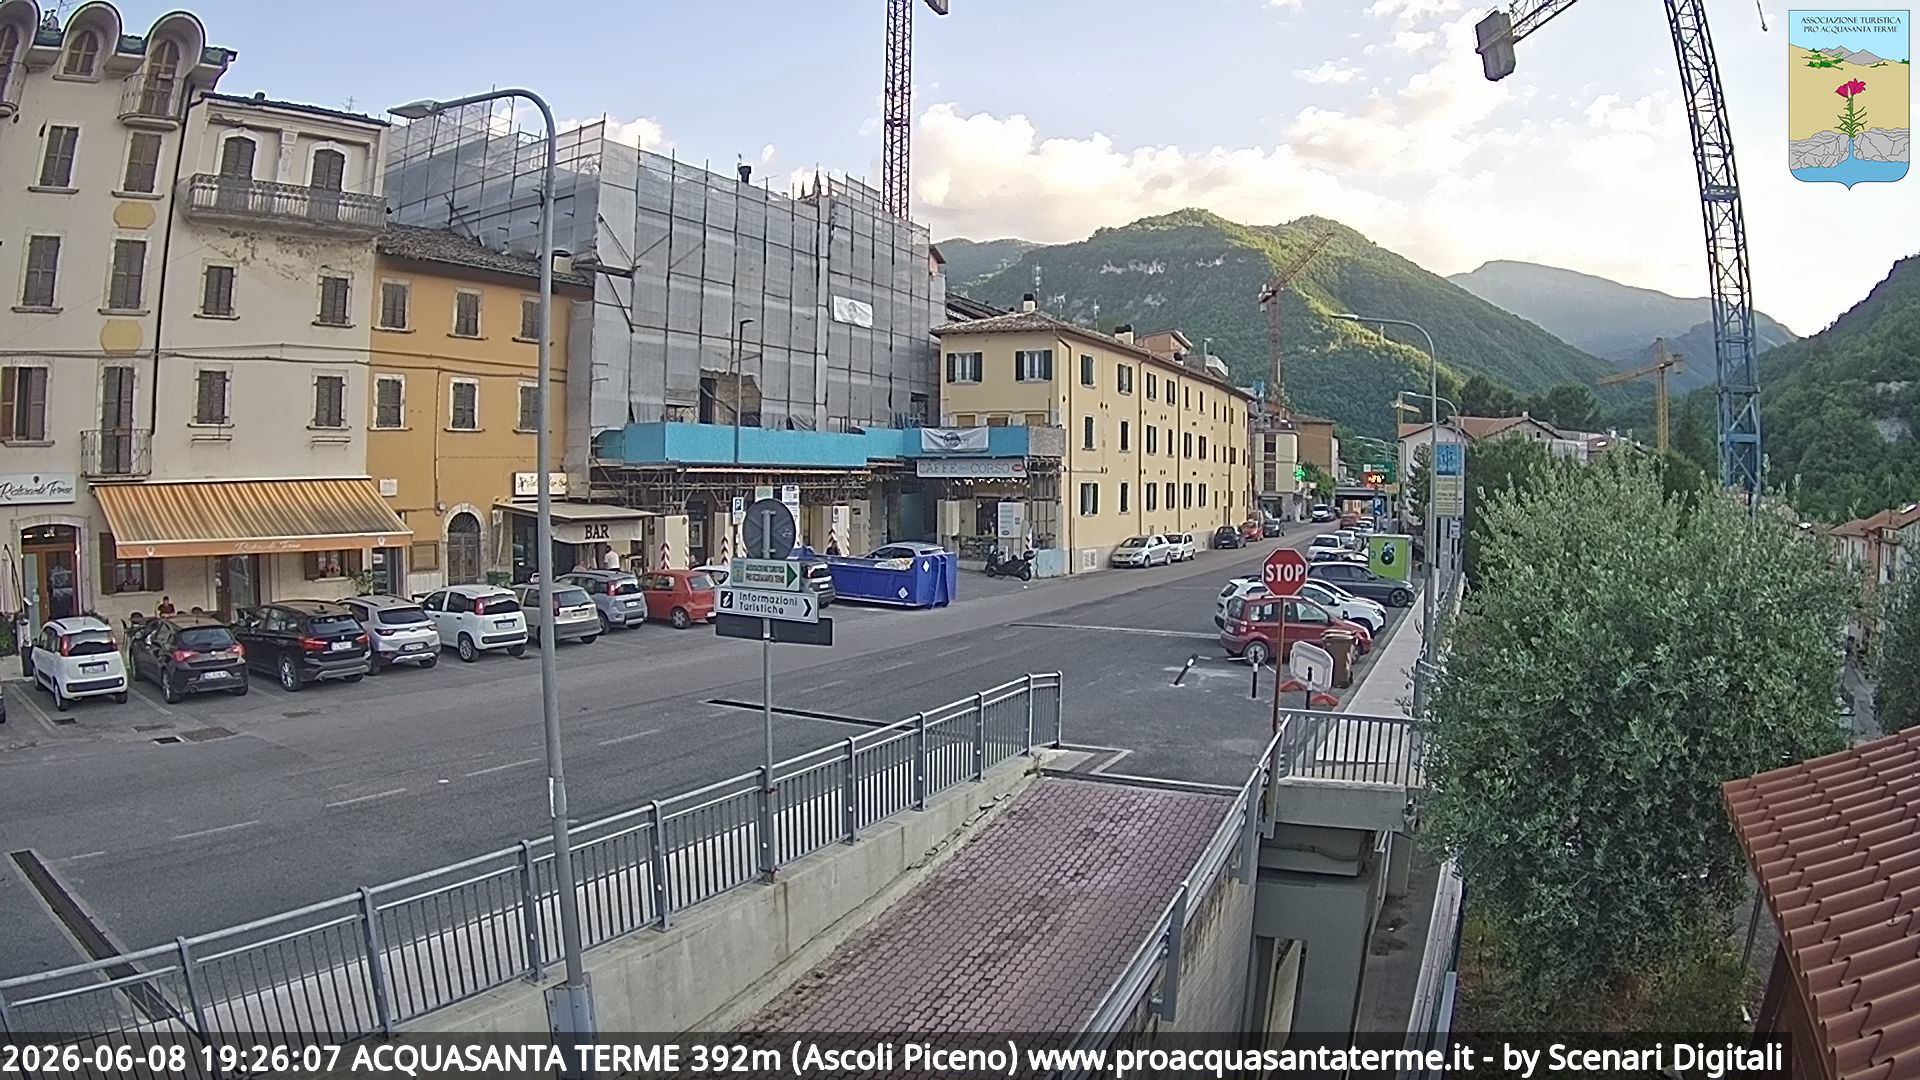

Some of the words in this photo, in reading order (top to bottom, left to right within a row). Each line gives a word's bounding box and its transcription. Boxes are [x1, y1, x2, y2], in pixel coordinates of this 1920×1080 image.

[970, 463, 1009, 475] CORSO
[584, 524, 610, 540] BAR
[1265, 563, 1304, 582] STOP
[739, 592, 798, 607] Informazioni
[739, 601, 784, 615] Turistiche
